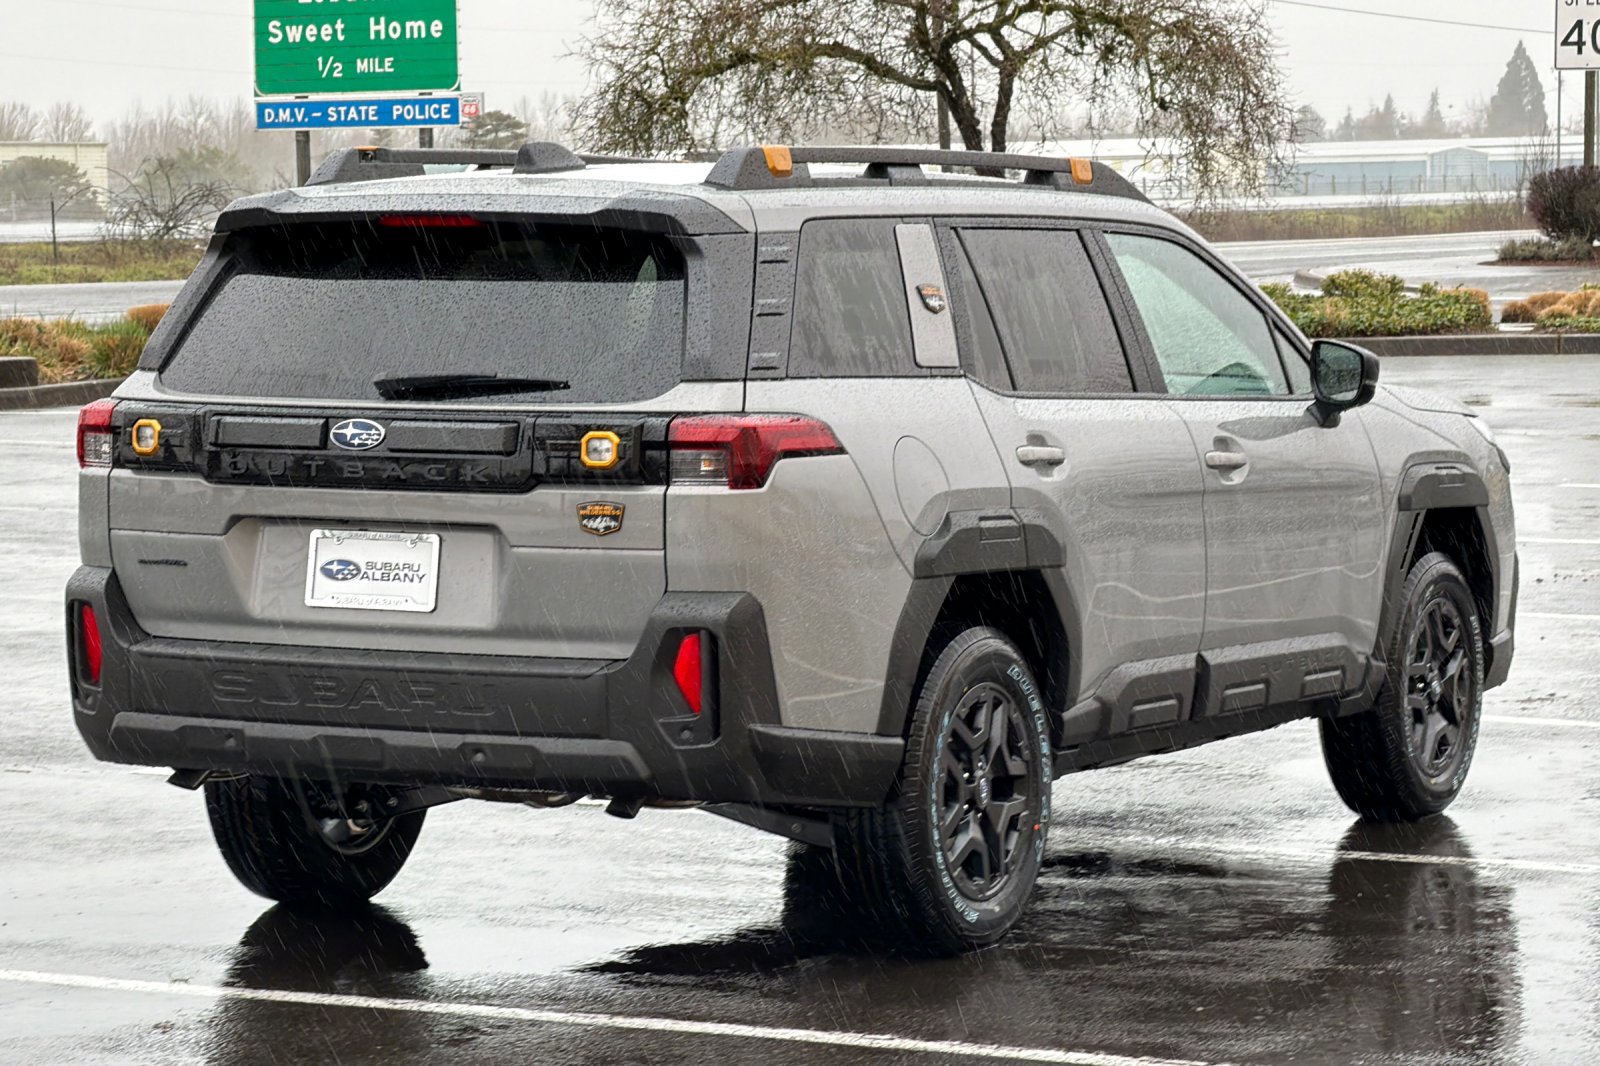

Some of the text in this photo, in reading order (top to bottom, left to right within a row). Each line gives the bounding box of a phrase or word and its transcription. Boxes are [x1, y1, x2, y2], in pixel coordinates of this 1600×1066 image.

[268, 16, 444, 44] Sweet Home
[356, 57, 395, 73] MILE
[327, 105, 379, 121] STATE
[392, 104, 451, 120] POLICE
[227, 454, 489, 482] OUTBACK
[365, 561, 421, 573] SUBARU
[359, 571, 427, 583] ALBANY
